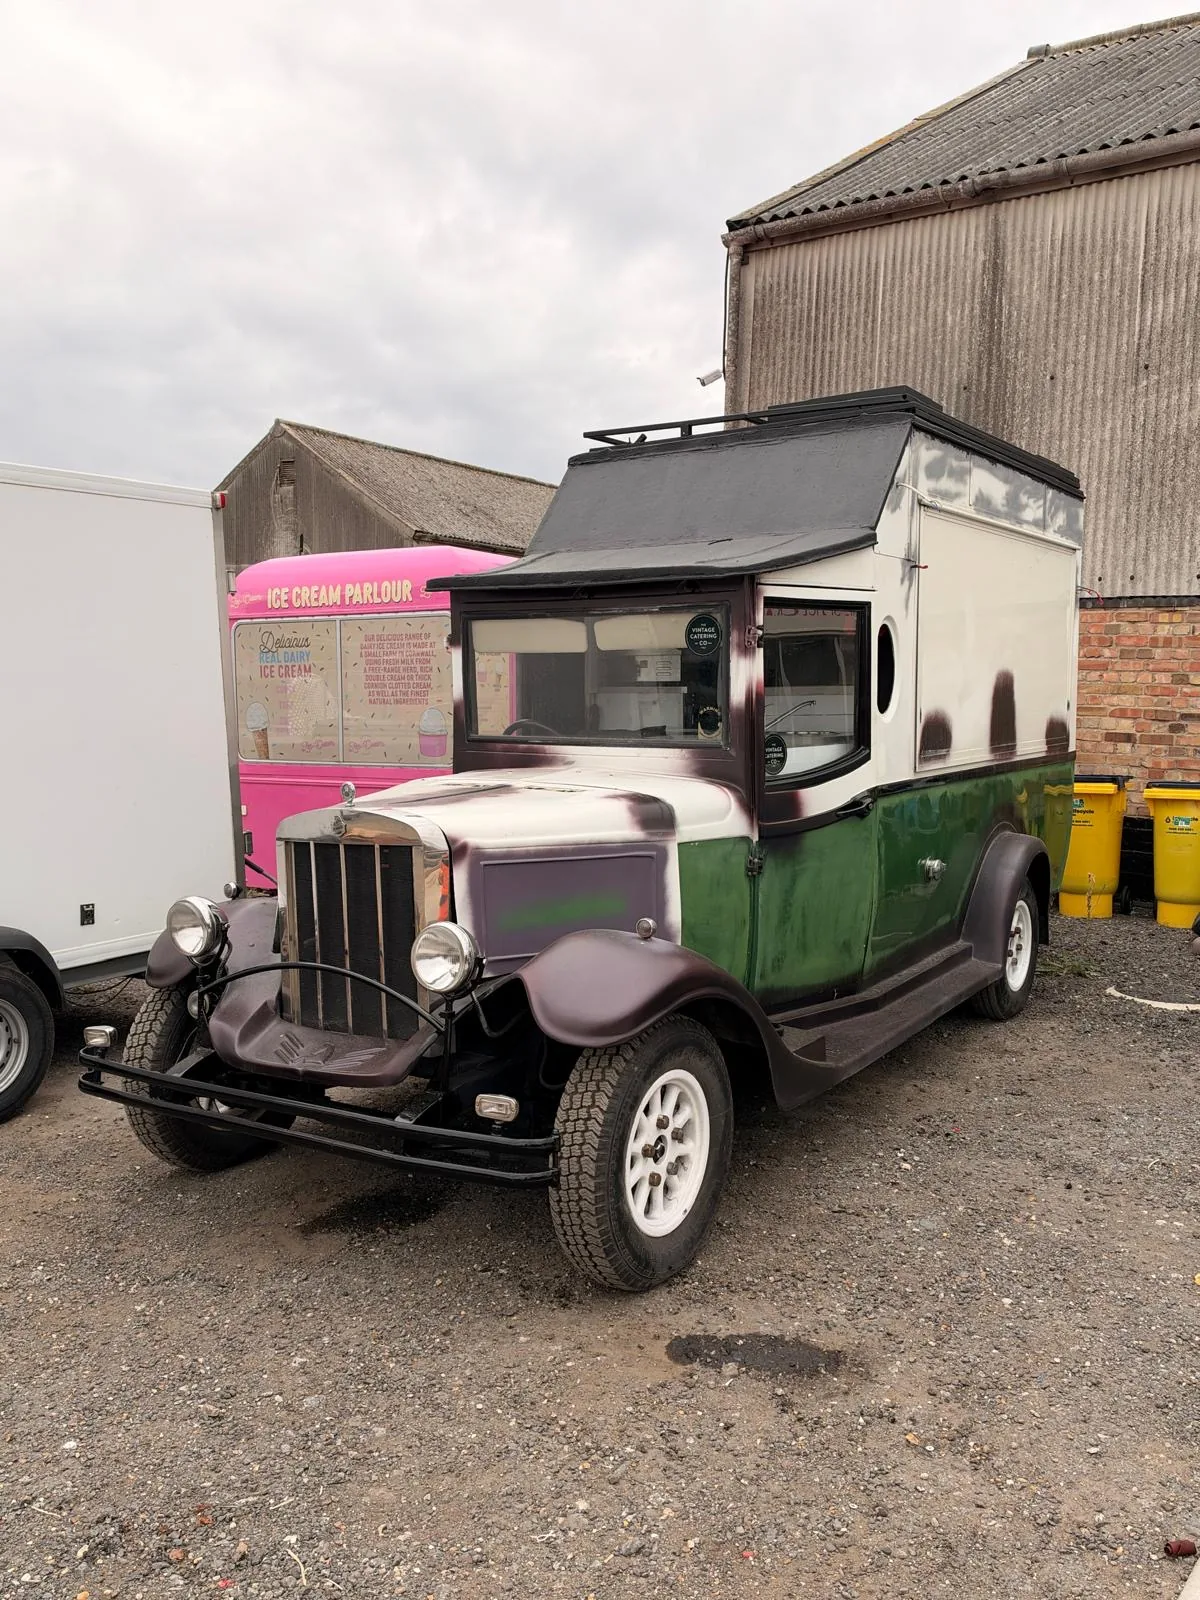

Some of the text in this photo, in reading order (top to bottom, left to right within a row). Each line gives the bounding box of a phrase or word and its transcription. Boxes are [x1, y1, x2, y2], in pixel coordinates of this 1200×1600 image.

[267, 587, 289, 609] ICE
[292, 584, 341, 608] CREAM
[345, 580, 412, 606] PARLOUR
[259, 631, 311, 653] Delicious
[376, 634, 404, 642] DELICIOUS
[404, 632, 423, 640] RANGE
[259, 651, 311, 664] REAL DAIRY
[260, 664, 312, 678] ICE CREAM
